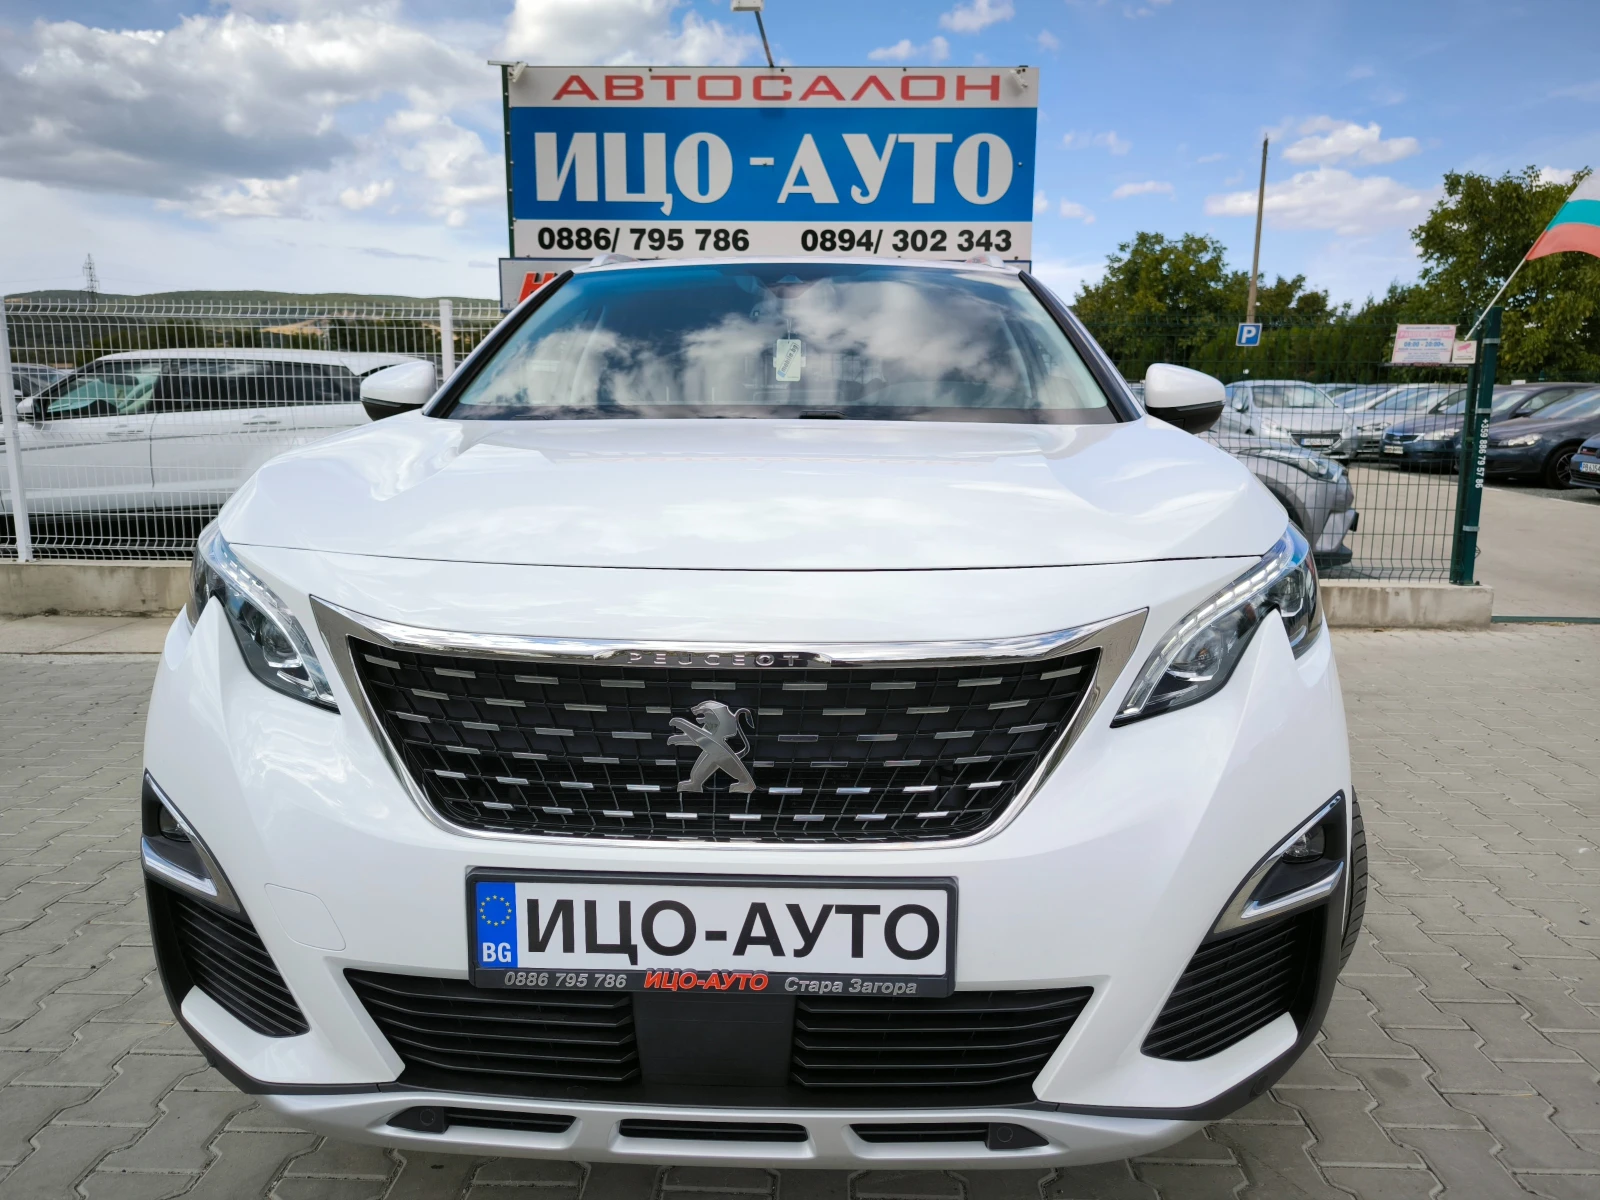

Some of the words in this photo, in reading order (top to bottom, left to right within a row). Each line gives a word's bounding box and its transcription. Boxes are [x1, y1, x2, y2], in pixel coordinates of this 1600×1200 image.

[553, 75, 1001, 101] АВТОСАЛОН
[538, 227, 621, 253] 0886/
[630, 227, 684, 251] 795
[695, 228, 750, 252] 786
[801, 229, 884, 254] 0894/
[892, 229, 948, 252] 302
[957, 229, 1012, 252] 343
[1241, 326, 1257, 344] P
[1480, 418, 1489, 438] +359
[1478, 439, 1488, 454] 886
[1477, 455, 1486, 466] 79
[1476, 466, 1485, 477] 57
[1475, 478, 1484, 489] 86
[526, 898, 940, 966] ИЦО-АУТО
[482, 942, 512, 963] BG
[504, 971, 549, 987] 0886
[555, 972, 589, 988] 795
[594, 973, 628, 989] 786
[643, 969, 770, 993] ИЦО-АУТО
[785, 976, 844, 995] Стара
[848, 978, 918, 996] Загора
